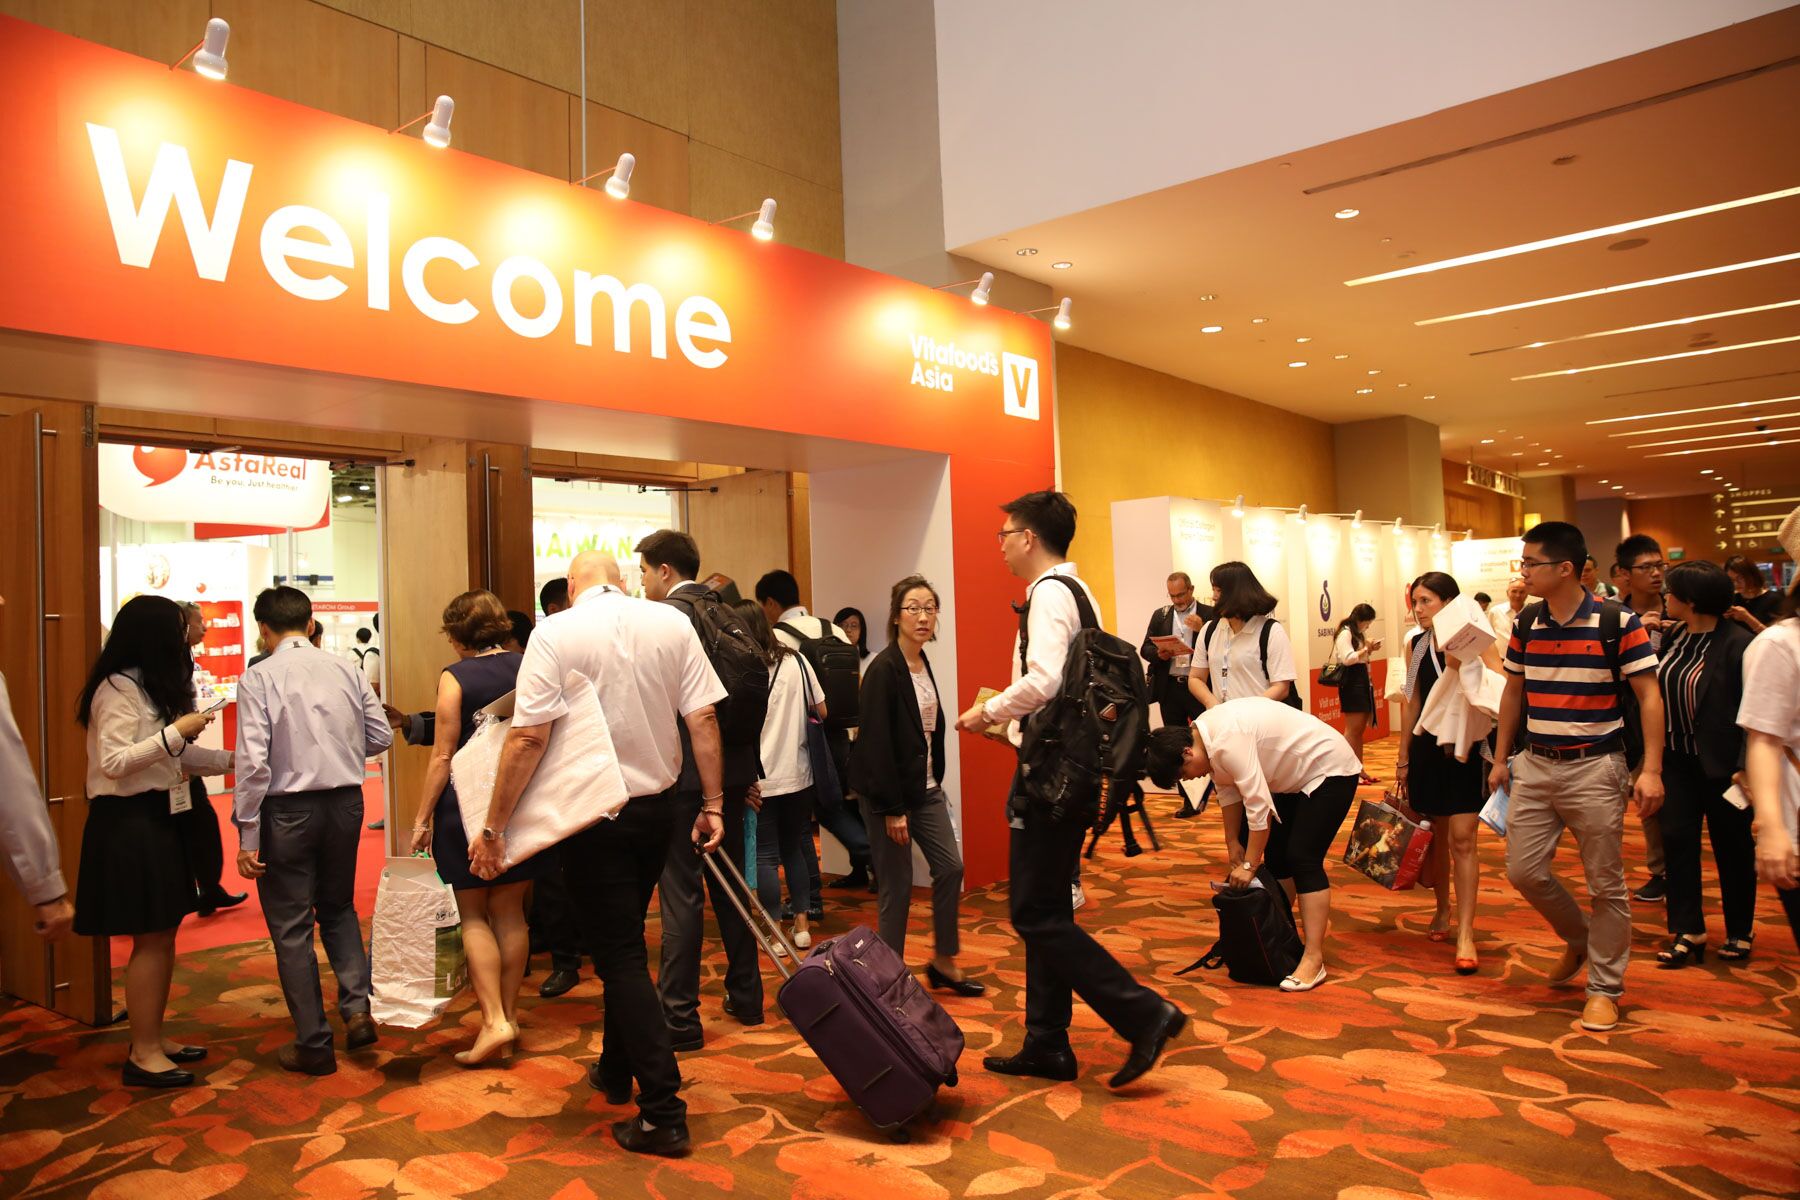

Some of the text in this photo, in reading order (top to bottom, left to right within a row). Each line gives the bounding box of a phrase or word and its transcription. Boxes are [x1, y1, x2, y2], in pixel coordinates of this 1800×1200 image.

[85, 122, 732, 369] Welcome
[910, 334, 1000, 376] Vitafoods
[911, 361, 954, 392] Asia
[194, 452, 306, 480] AstaReal
[211, 475, 223, 485] Be
[247, 479, 264, 488] Just
